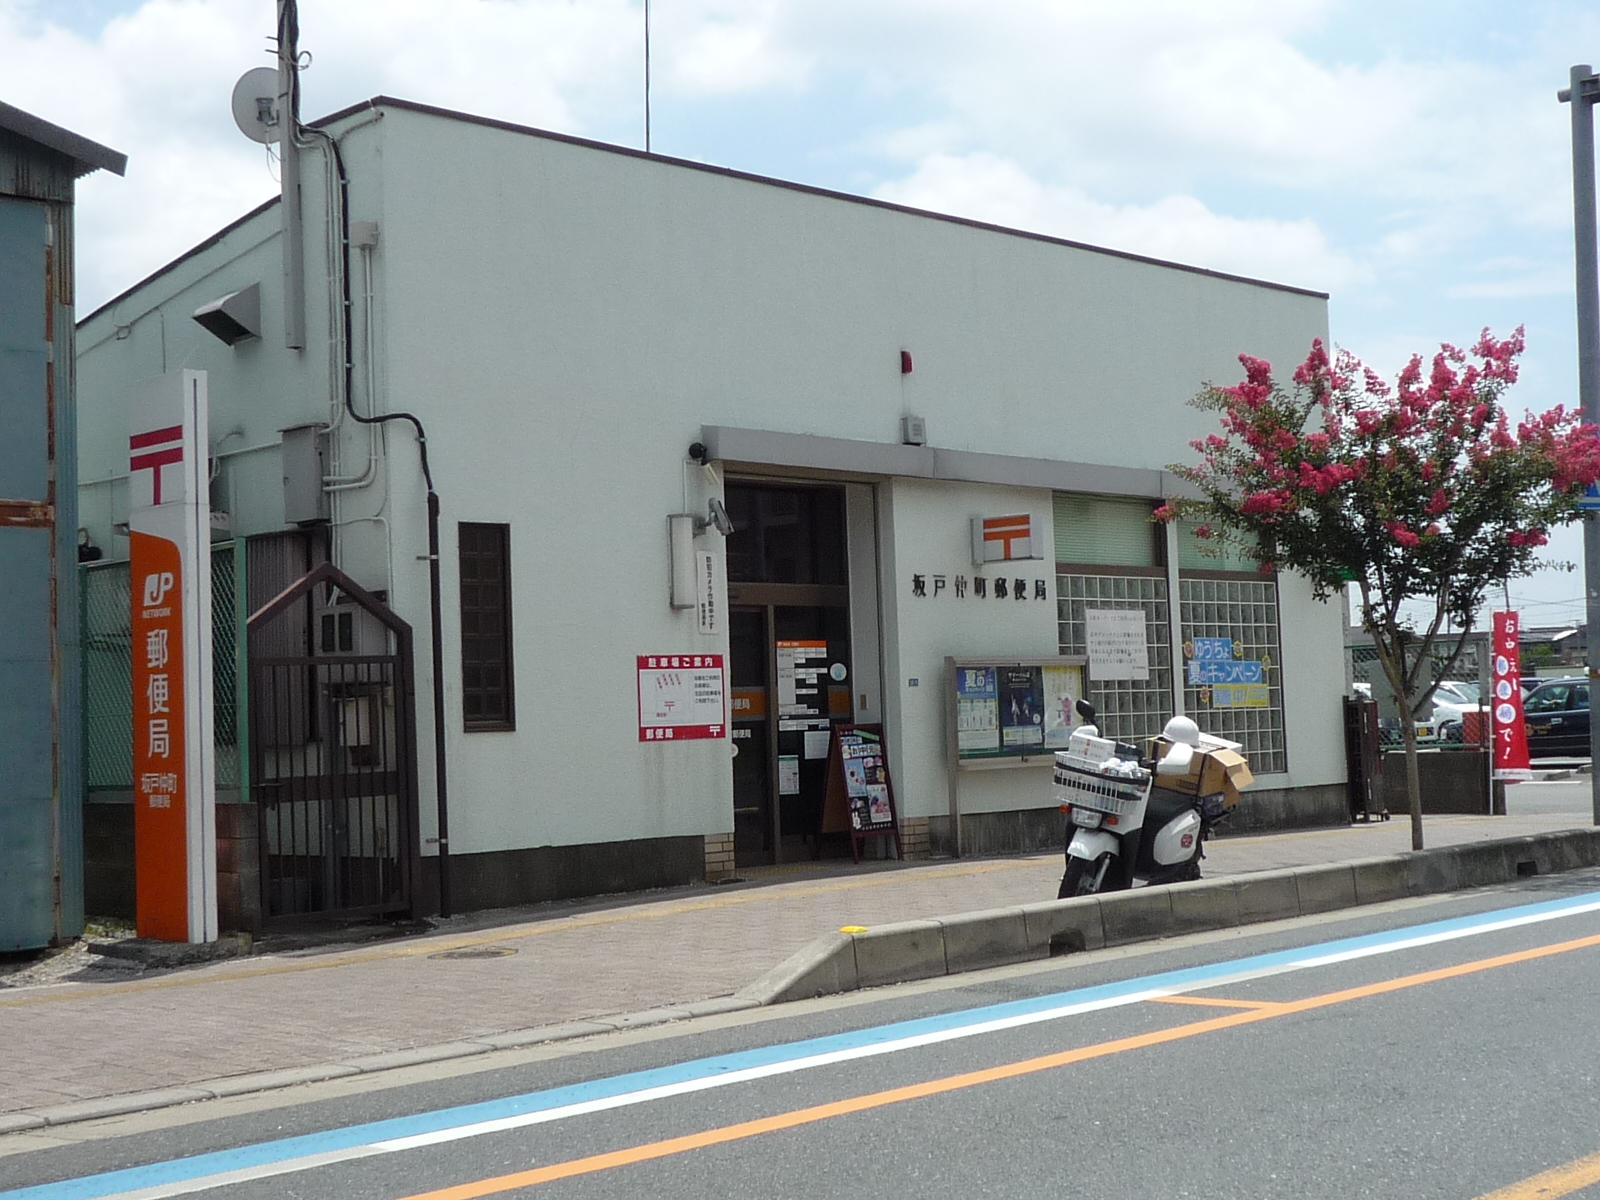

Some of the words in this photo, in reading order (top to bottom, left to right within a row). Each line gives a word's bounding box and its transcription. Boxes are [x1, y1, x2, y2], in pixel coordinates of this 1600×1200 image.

[912, 573, 1047, 601] 坂戸仲町郵便局
[1194, 640, 1230, 659] ゆうちょ
[648, 656, 713, 668] 駐車場ご案内
[1188, 661, 1261, 685] 夏のキャンペーン
[146, 628, 170, 759] 郵便局
[646, 728, 673, 740] 郵便局
